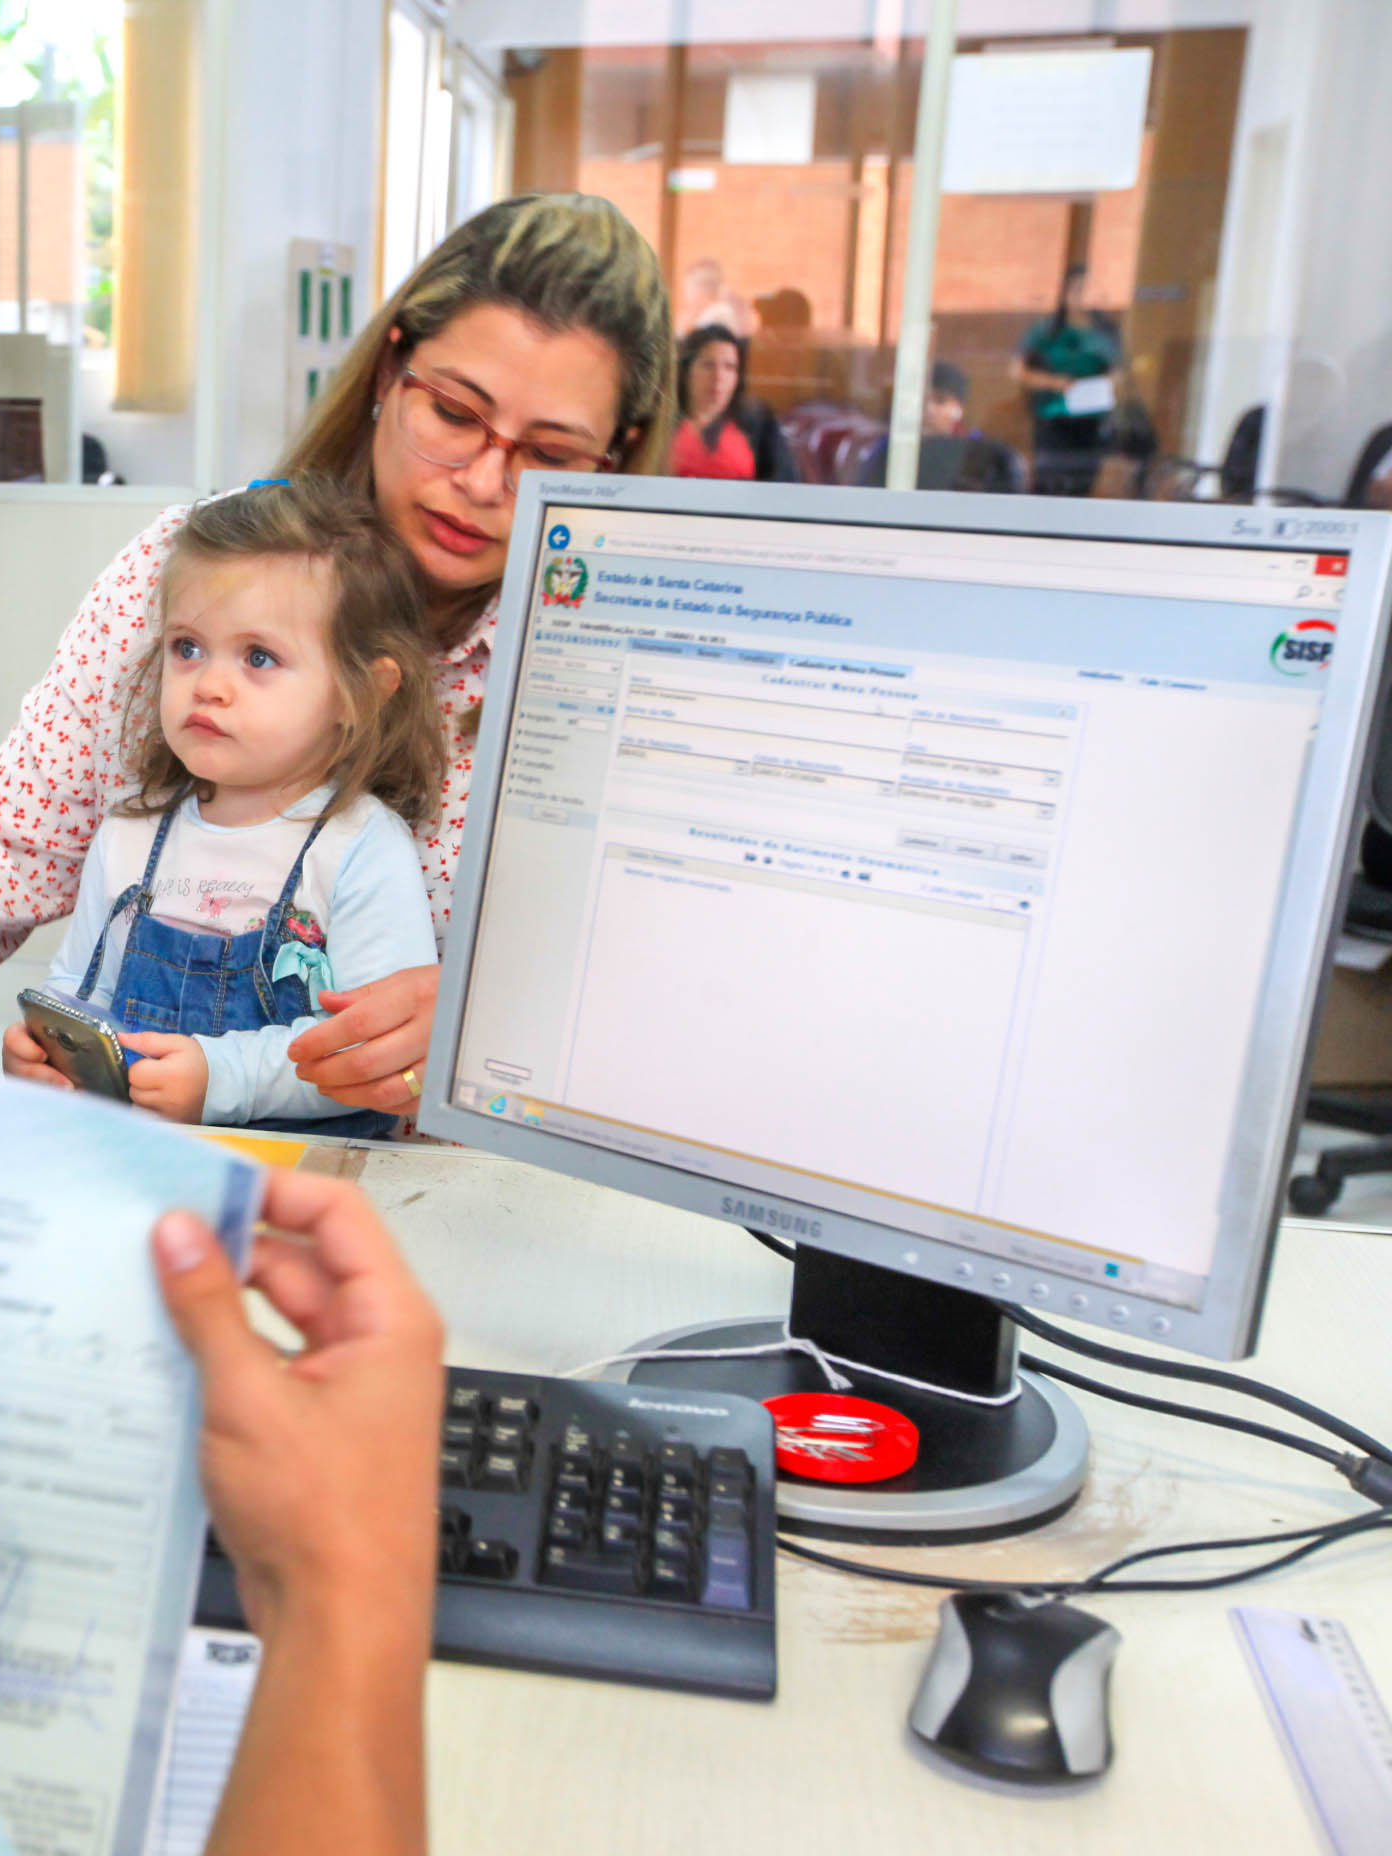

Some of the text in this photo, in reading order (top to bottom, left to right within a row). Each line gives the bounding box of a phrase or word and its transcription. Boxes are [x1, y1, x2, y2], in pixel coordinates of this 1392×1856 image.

[597, 571, 744, 594] Estado de Santa Catarina
[594, 592, 852, 627] Secretaria de Estado da Segurança Pública
[789, 658, 838, 672] Cadastrar
[840, 664, 866, 675] Nova
[869, 666, 906, 678] Pessoa
[762, 673, 918, 701] Cadastrar Nova Pessoa
[720, 1196, 823, 1239] SAMSUNG
